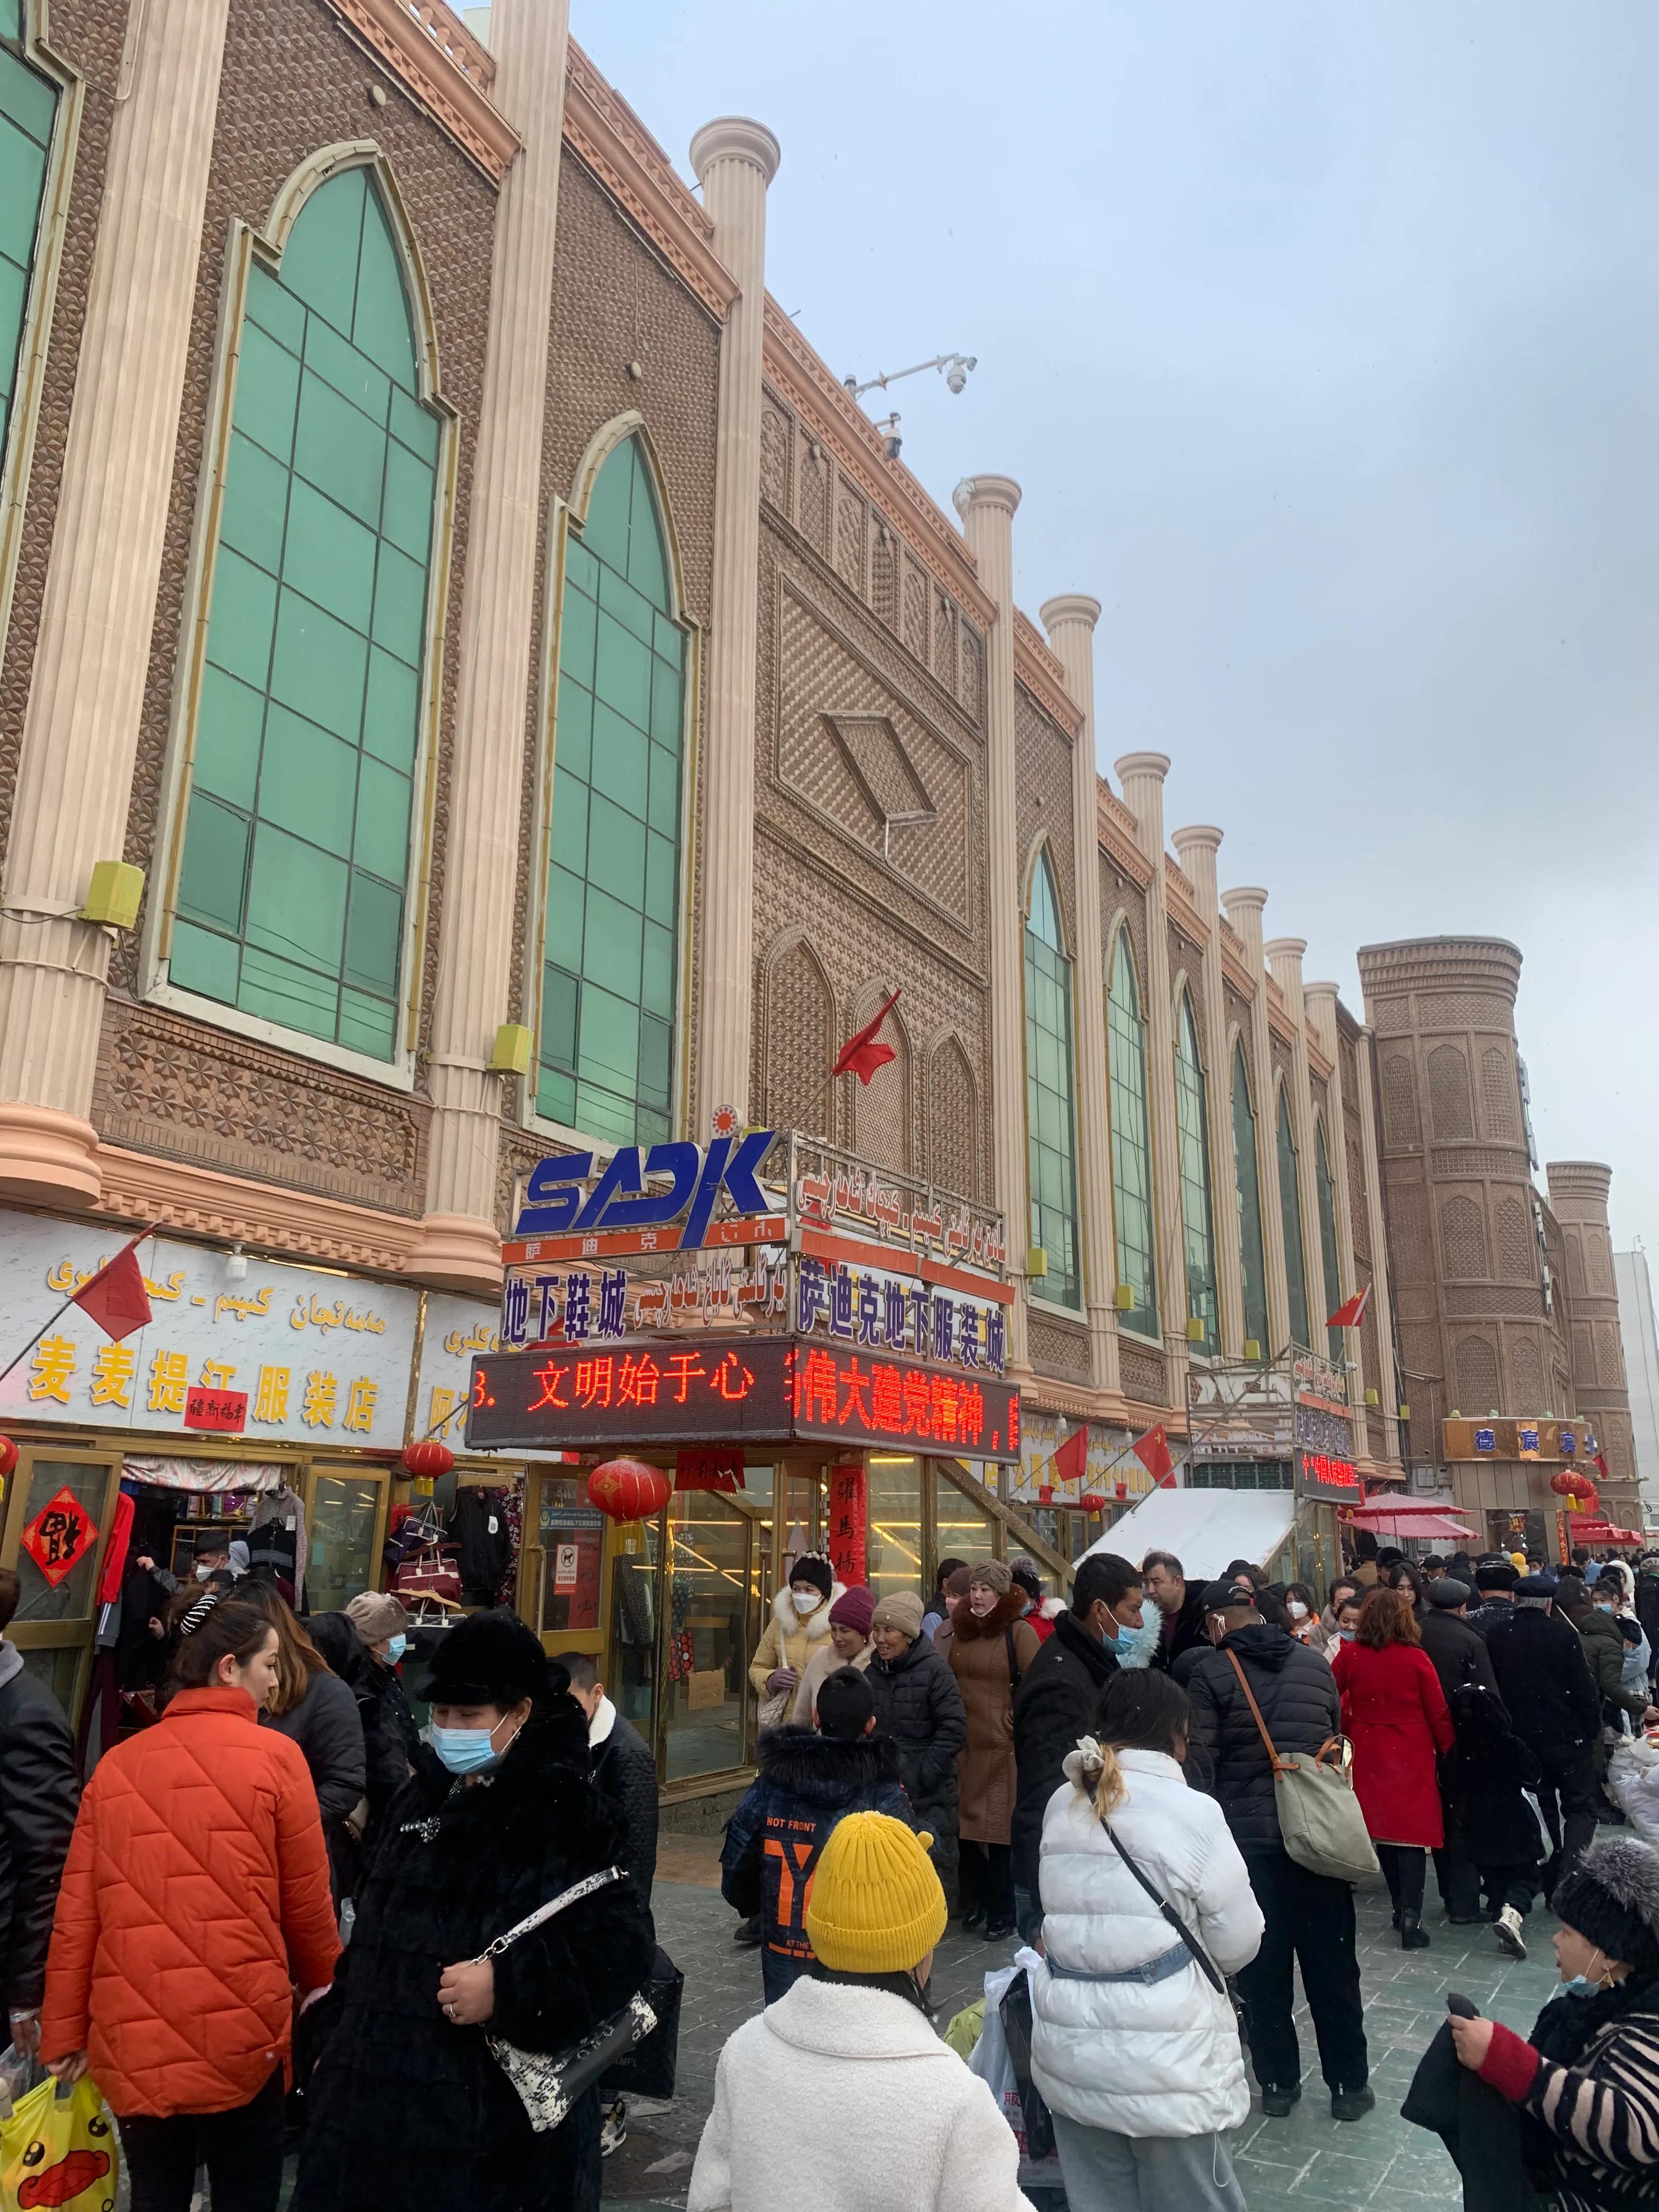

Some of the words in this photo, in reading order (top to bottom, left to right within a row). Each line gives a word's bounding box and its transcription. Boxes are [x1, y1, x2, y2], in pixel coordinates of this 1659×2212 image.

[525, 1233, 657, 1260] 萨迪克
[503, 1269, 627, 1344] 地下鞋城
[797, 1259, 1005, 1374] 萨迪克地下服装城
[29, 1333, 379, 1432] 麦麦提江服装店
[527, 1351, 755, 1412] 文明始于心
[39, 1510, 82, 1566] 福
[767, 1816, 785, 1828] NOT
[788, 1820, 816, 1832] FRONT
